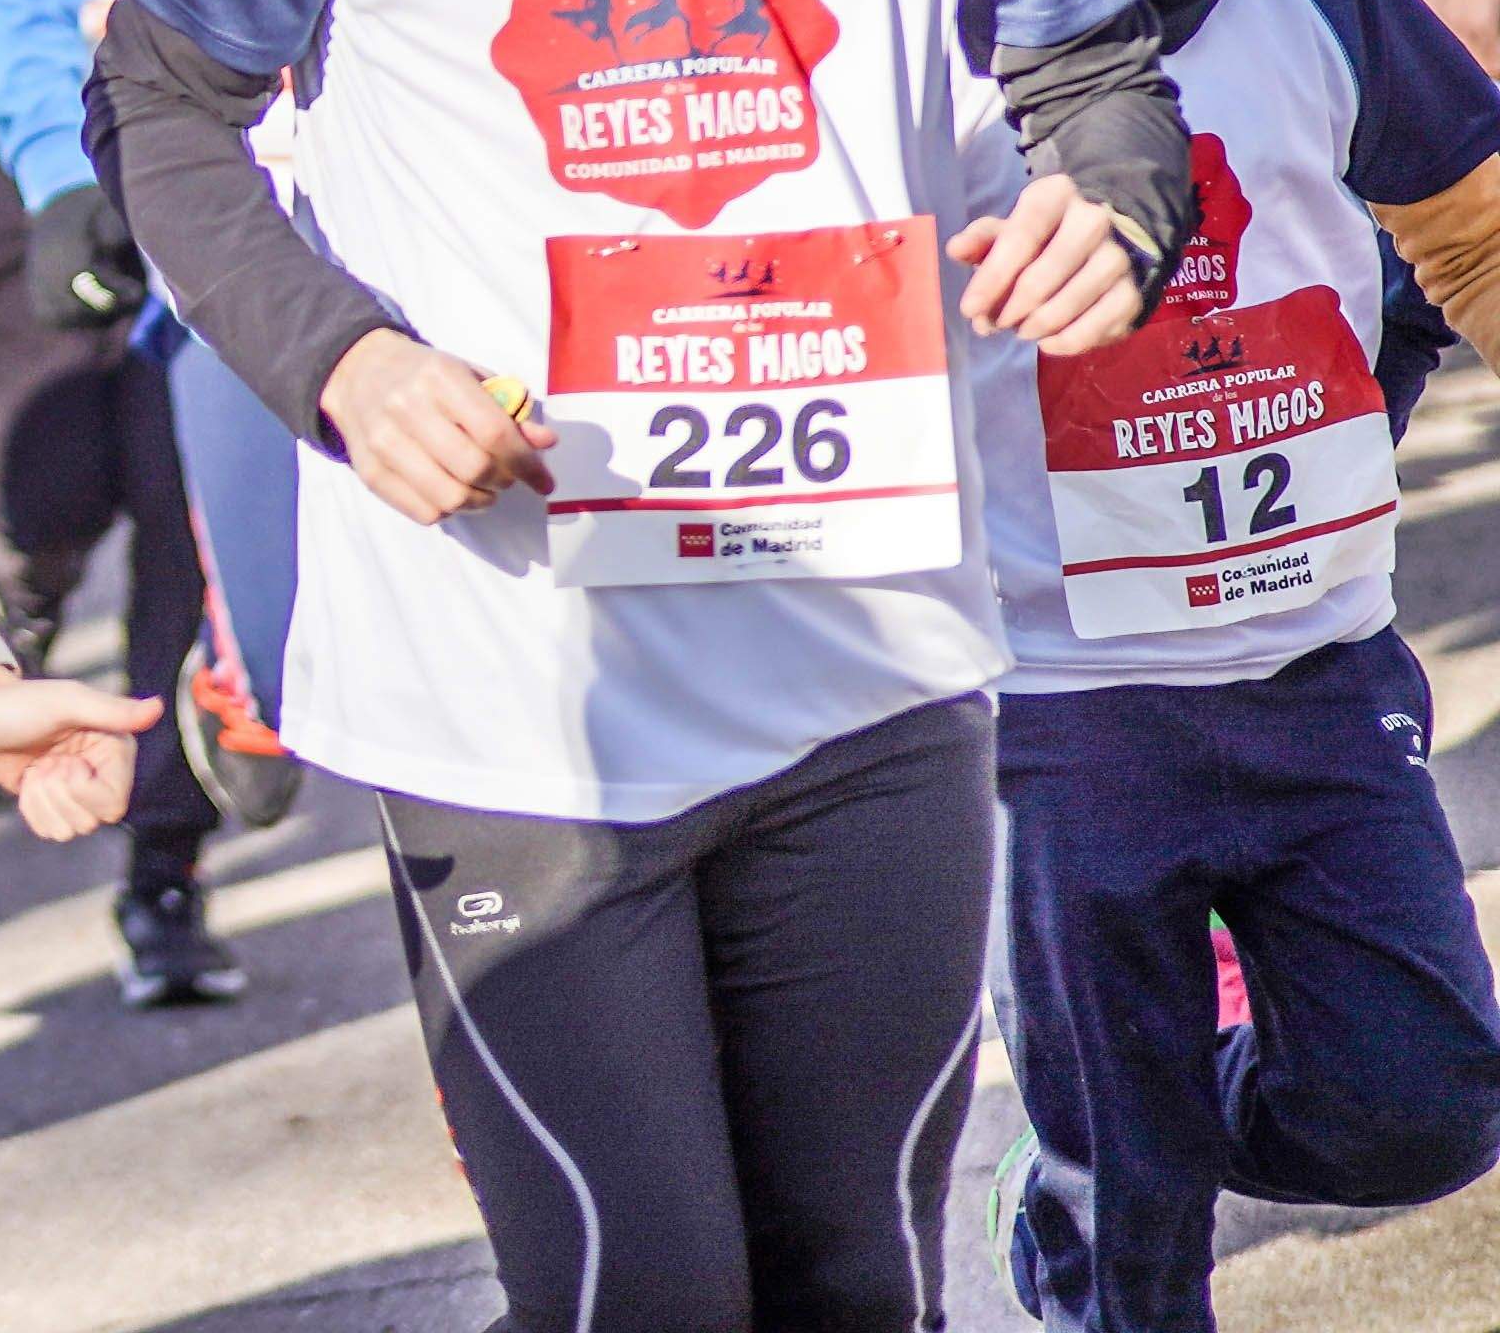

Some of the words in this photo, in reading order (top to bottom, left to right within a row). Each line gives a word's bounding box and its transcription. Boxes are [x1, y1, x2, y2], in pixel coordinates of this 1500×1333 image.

[577, 60, 680, 90] CARRERA
[683, 57, 778, 77] POPULAR
[559, 97, 673, 151] REYES
[685, 85, 805, 142] MAGOS
[564, 154, 692, 180] COMUNIDAD
[697, 150, 725, 168] DE
[726, 142, 806, 165] MADRID
[652, 304, 748, 324] CARRERA
[750, 301, 833, 318] POPULAR
[615, 333, 735, 385] REYES
[748, 325, 868, 385] MAGOS
[1142, 378, 1221, 405] CARRERA
[1224, 365, 1297, 388] POPULAR
[1212, 391, 1224, 403] de
[1112, 409, 1217, 459] REYES
[1227, 381, 1325, 445] MAGOS
[647, 398, 852, 488] 226
[1183, 452, 1297, 544] 12
[719, 517, 823, 536] Comunidad
[720, 541, 743, 557] de
[752, 536, 823, 553] Madrid
[1225, 586, 1245, 602] de
[1251, 569, 1314, 595] Madrid
